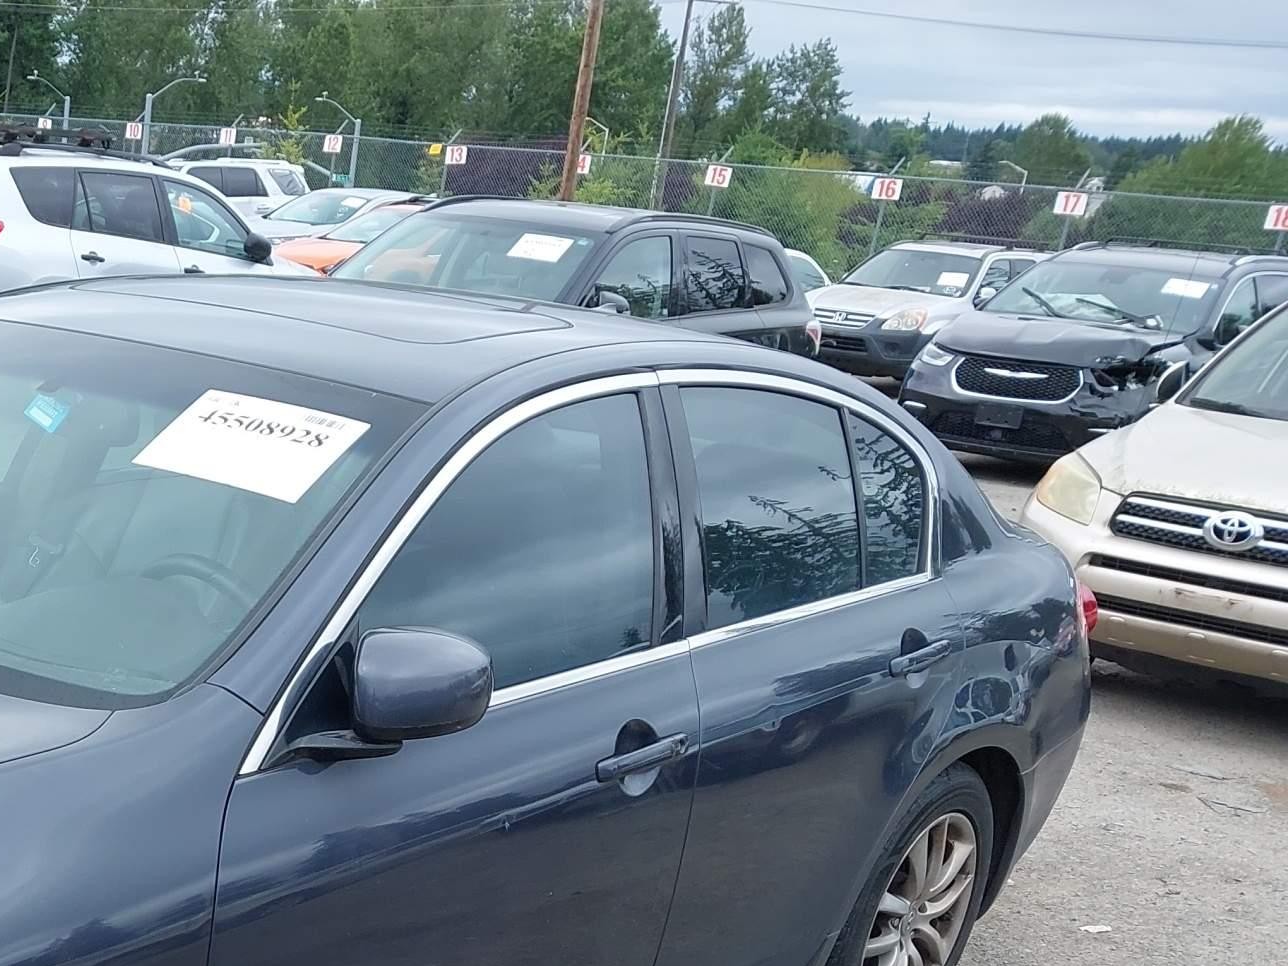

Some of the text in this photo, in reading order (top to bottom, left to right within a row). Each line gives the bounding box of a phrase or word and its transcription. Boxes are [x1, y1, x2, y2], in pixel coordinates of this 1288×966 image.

[129, 124, 140, 138] 10
[223, 129, 233, 143] 11
[328, 137, 339, 150] 12
[450, 146, 463, 163] 13
[577, 155, 587, 172] 4
[712, 166, 728, 185] 15
[878, 179, 897, 198] 16
[1063, 193, 1082, 213] 17
[198, 409, 330, 448] 45508928
